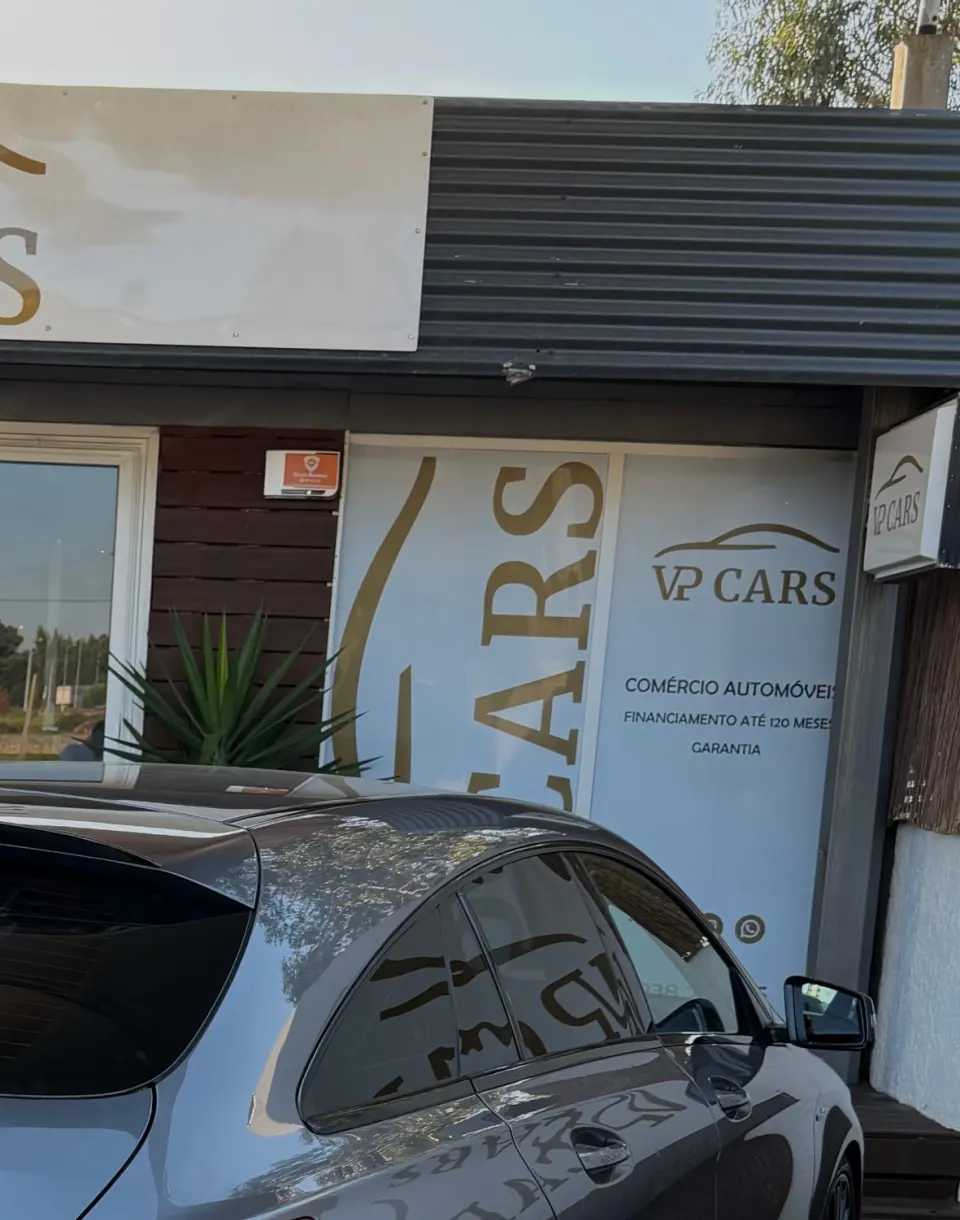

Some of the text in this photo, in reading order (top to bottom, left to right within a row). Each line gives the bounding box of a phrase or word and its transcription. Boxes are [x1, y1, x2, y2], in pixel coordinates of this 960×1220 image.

[874, 491, 921, 536] VP CARS
[652, 565, 836, 606] VP CARS
[625, 676, 719, 696] COMÉRCIO
[624, 711, 737, 727] FINANCIAMENTO
[740, 713, 766, 728] ATÉ
[691, 741, 761, 756] GARANTIA
